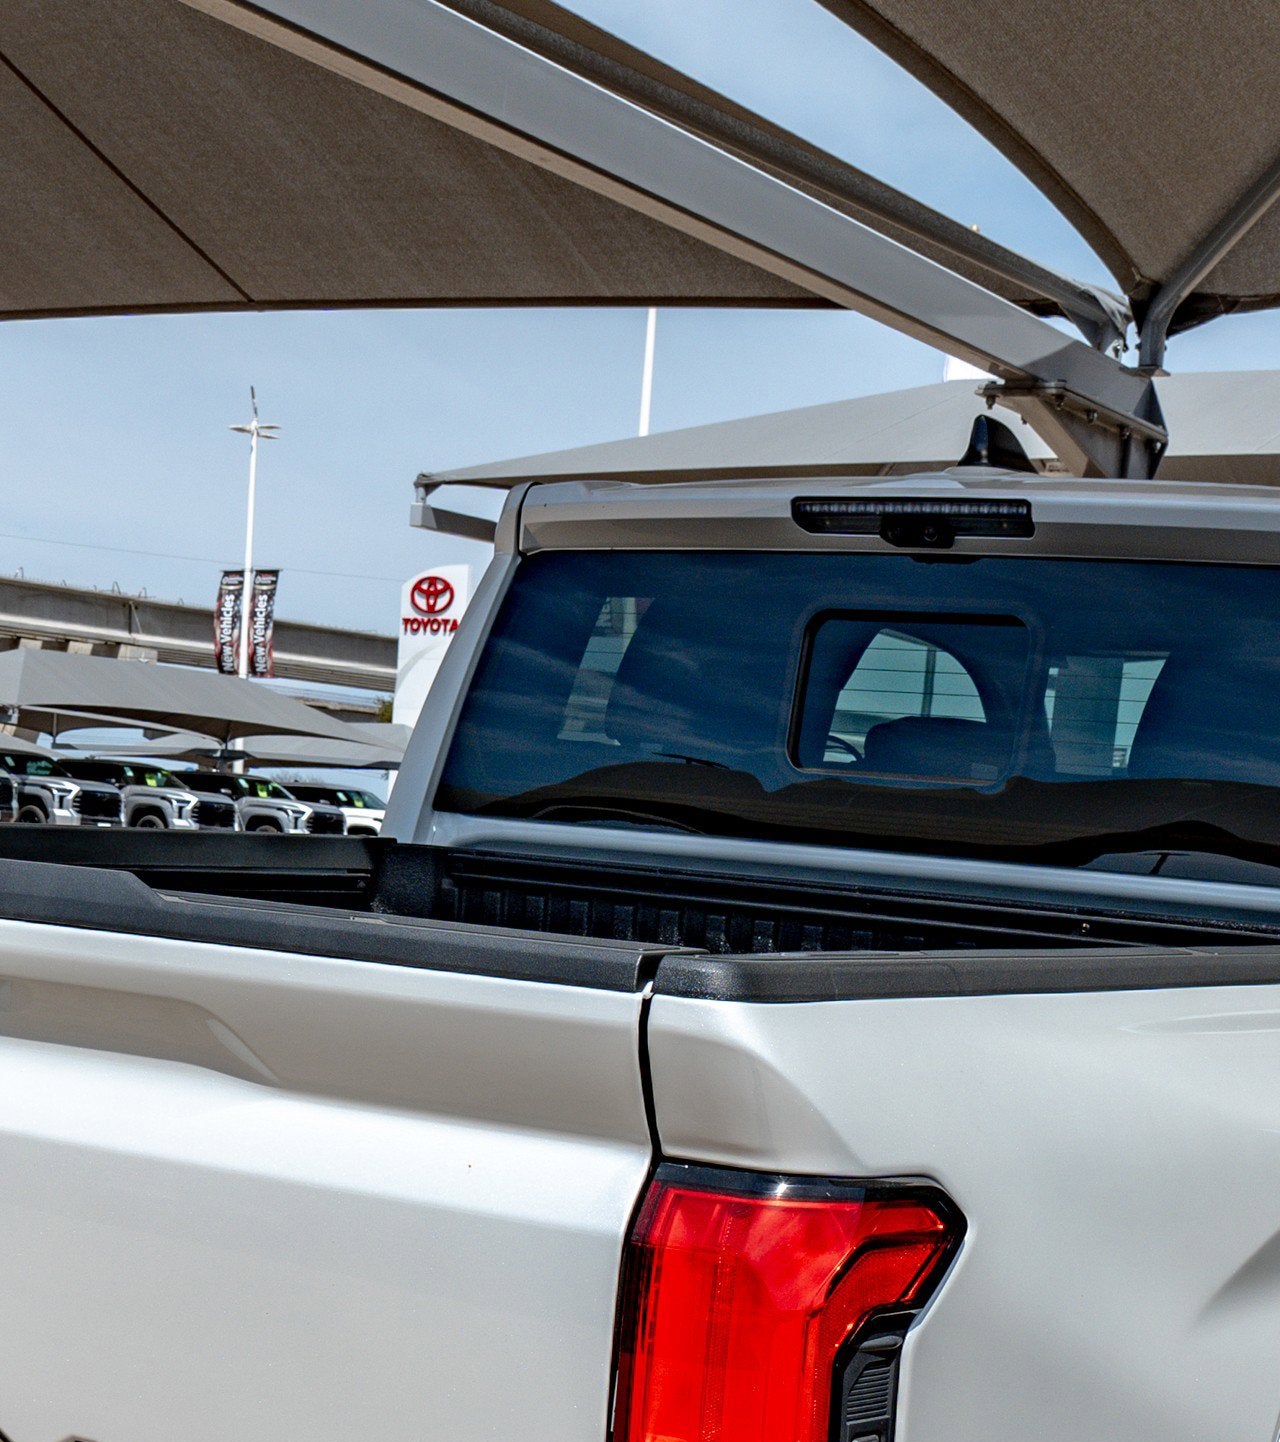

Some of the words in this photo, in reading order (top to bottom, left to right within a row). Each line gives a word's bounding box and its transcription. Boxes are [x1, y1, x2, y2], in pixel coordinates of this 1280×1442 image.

[220, 594, 235, 643] Vehicles
[253, 594, 268, 643] Vehicles
[402, 618, 459, 634] TOYOTA
[222, 645, 234, 671] New
[255, 646, 267, 672] New
